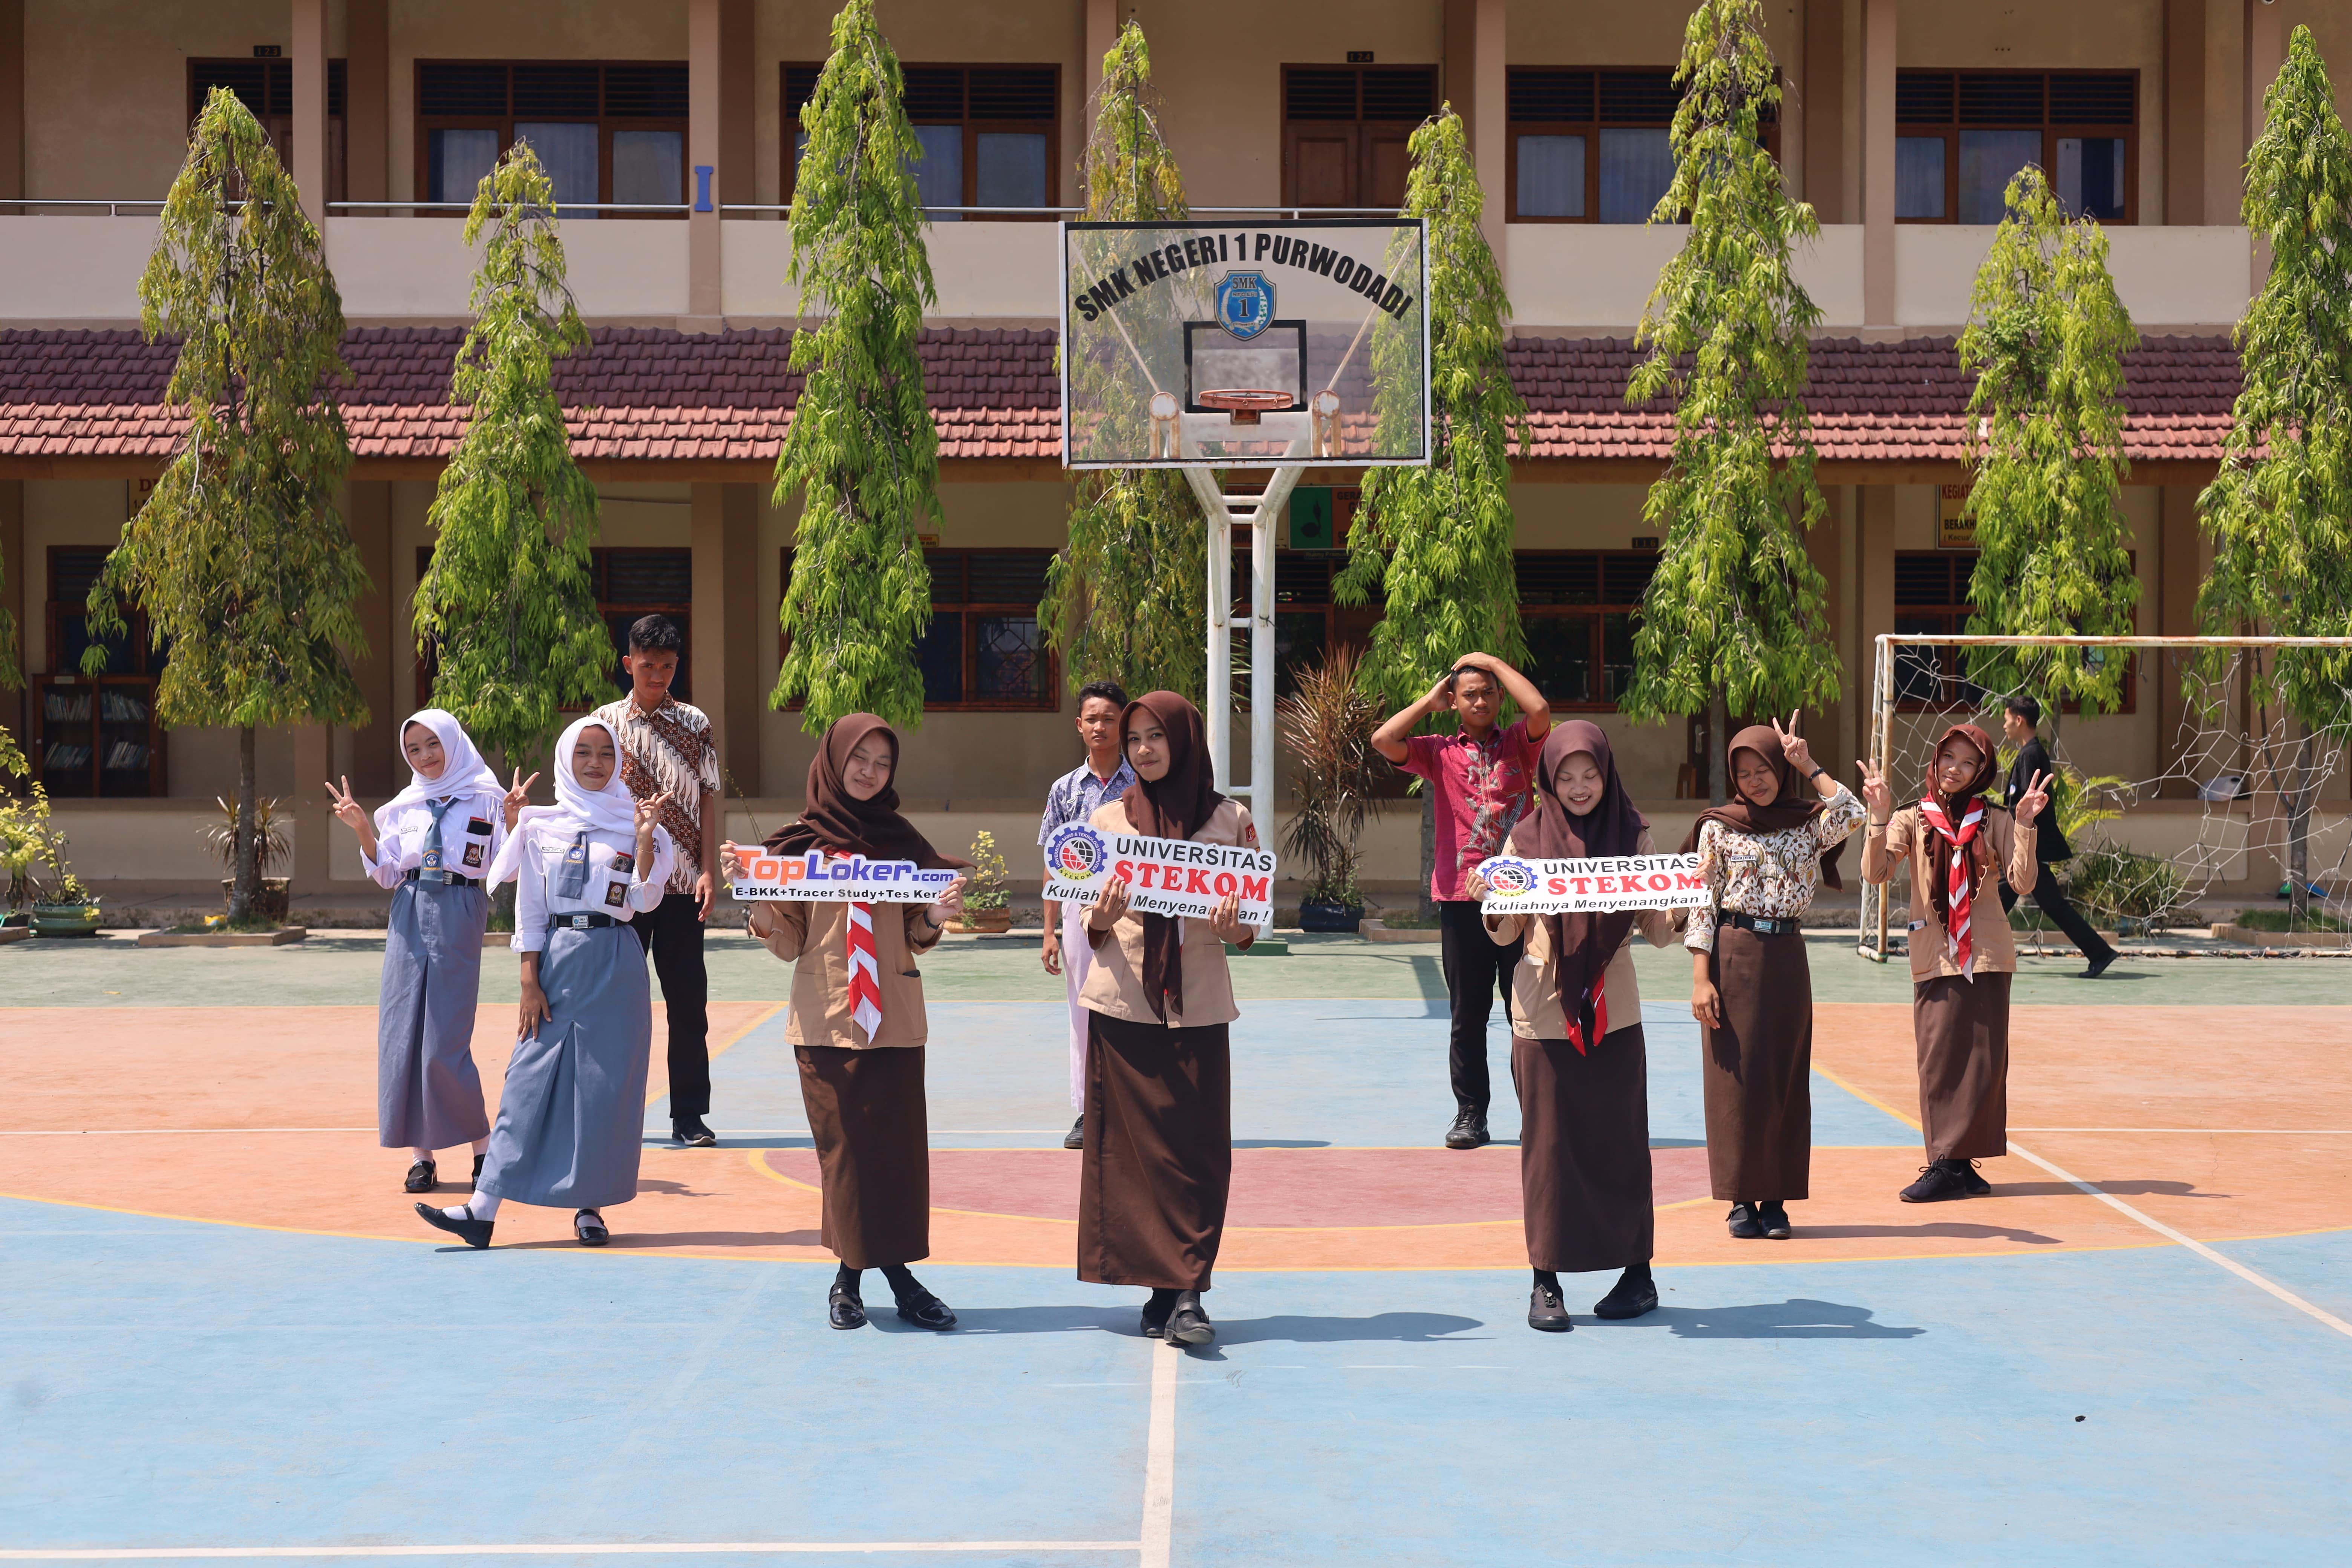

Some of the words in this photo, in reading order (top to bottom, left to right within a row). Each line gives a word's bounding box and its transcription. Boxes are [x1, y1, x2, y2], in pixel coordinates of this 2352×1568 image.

[1075, 268, 1137, 322] SMK
[1132, 234, 1228, 286] NEGERI
[1234, 233, 1246, 261] 1
[1255, 233, 1413, 320] PURWODADI
[1232, 277, 1257, 289] SMK
[1239, 299, 1249, 317] 1
[1945, 519, 1977, 530] BERAKH
[1054, 841, 1063, 867] UNIVERSITAS
[1061, 833, 1074, 842] SAINS
[1078, 832, 1099, 849] TEKNOLOGI
[1091, 848, 1101, 871] KOMPUTER
[1116, 838, 1272, 872] UNIVERSITAS
[1544, 856, 1698, 875] UNIVERSITAS
[1059, 870, 1092, 880] STEKOM
[1113, 860, 1269, 902] STEKOM
[1548, 873, 1703, 895] STEKOM
[735, 887, 834, 897] E-BKK+Tracer
[838, 888, 910, 900] Study+Tes
[1487, 900, 1569, 911] Kuliahnya
[1574, 896, 1699, 909] Menyenangkan
